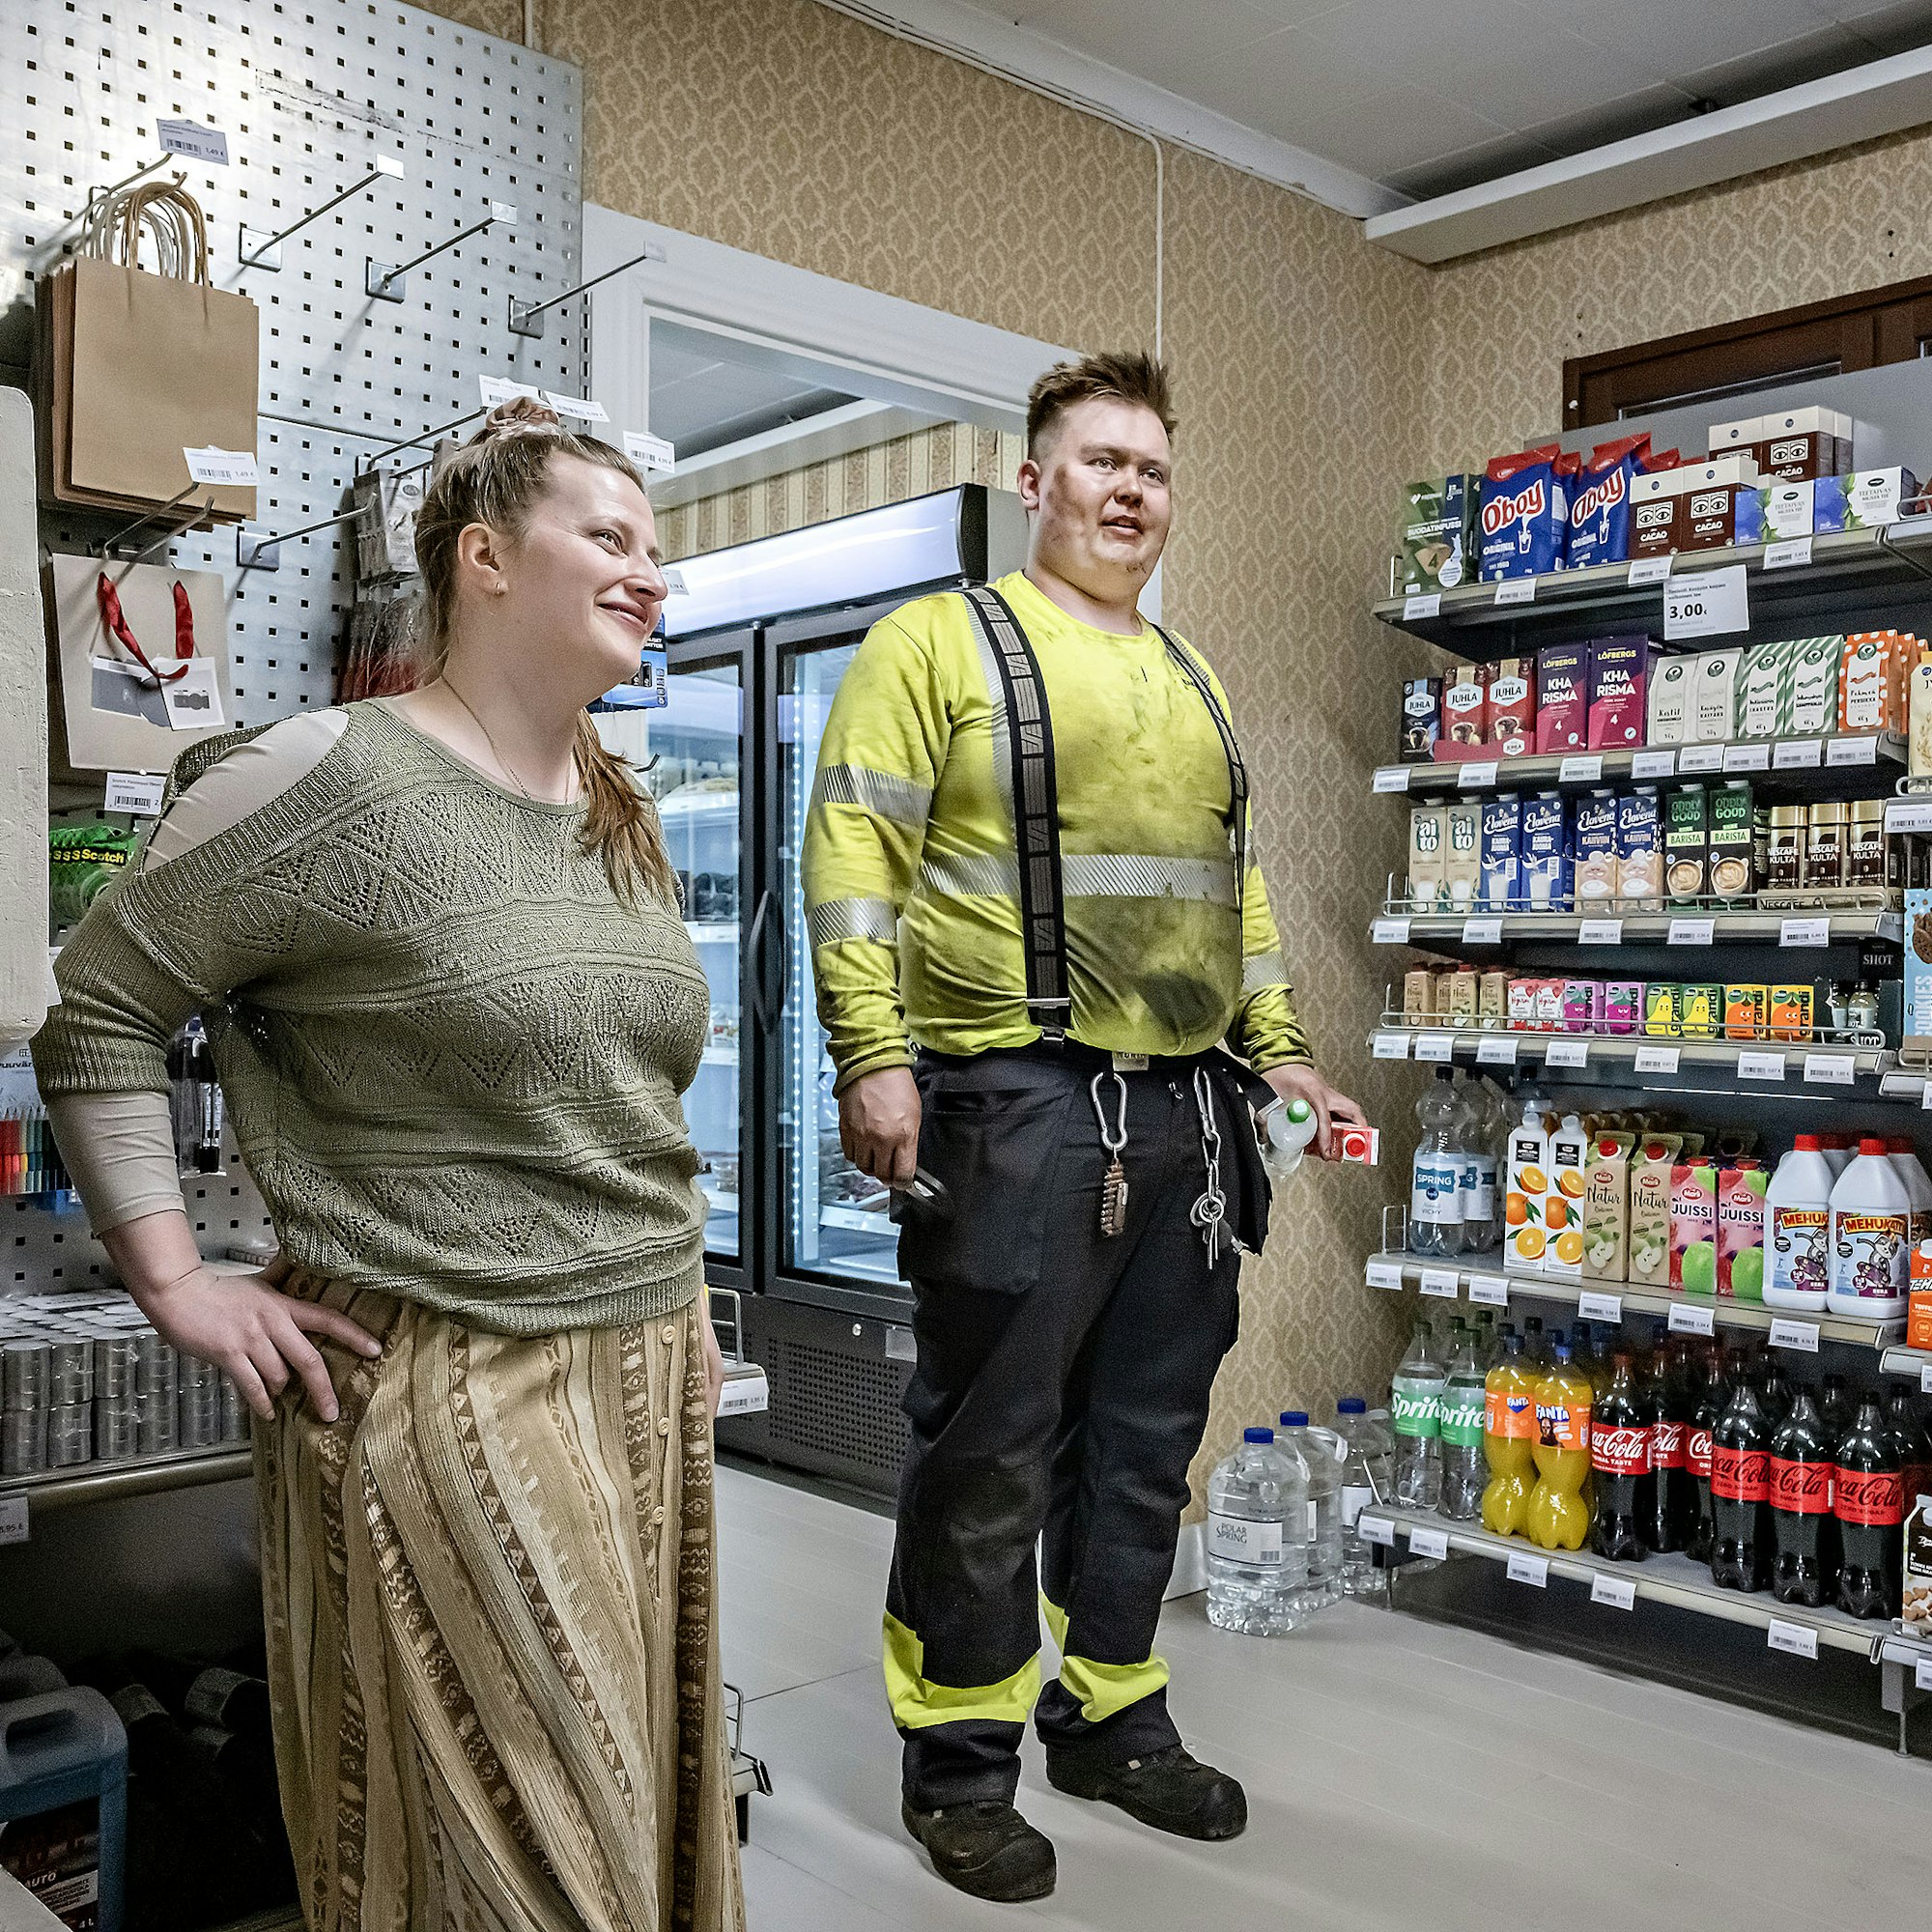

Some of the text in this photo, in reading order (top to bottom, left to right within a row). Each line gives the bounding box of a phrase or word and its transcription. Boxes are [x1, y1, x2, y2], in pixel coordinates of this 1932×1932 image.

[1483, 480, 1545, 535] O'boy
[1694, 521, 1723, 532] CACAO
[1640, 530, 1668, 542] CACAO
[1429, 554, 1437, 568] 4
[1597, 650, 1636, 661] LÖFBERGS
[1543, 658, 1578, 669] LÖFBERGS
[1603, 668, 1631, 683] KHA
[1548, 677, 1573, 691] KHA
[1596, 683, 1636, 697] RISMA
[1451, 693, 1478, 704] JUHLA
[1494, 686, 1522, 699] JUHLA
[1542, 690, 1578, 705] RISMA
[1409, 701, 1431, 710] JUHLA
[1554, 720, 1563, 731] 4
[1609, 714, 1619, 725] 4
[1671, 800, 1700, 811] ODDLY
[1715, 797, 1747, 809] ODDLY
[1619, 809, 1657, 830] Elovena
[1671, 811, 1701, 822] GOOD
[1715, 808, 1747, 819] GOOD
[1419, 817, 1437, 837] ai
[1455, 815, 1472, 836] ai
[1484, 814, 1519, 835] Elovena
[1523, 812, 1561, 833] Elovena
[1577, 810, 1616, 832] Elovena
[1419, 835, 1438, 851] to
[1455, 835, 1474, 850] to
[1670, 835, 1701, 844] BARISTA
[1715, 832, 1747, 842] BARISTA
[1769, 855, 1797, 865] KULTA
[1810, 852, 1837, 863] KULTA
[1853, 851, 1882, 860] KULTA
[1863, 953, 1893, 966] SHOT
[1670, 988, 1681, 1031] grandi
[1707, 989, 1718, 1033] grandi
[1753, 990, 1764, 1035] grandi
[1800, 990, 1810, 1036] grandi
[1416, 1173, 1452, 1187] SPRING
[1587, 1183, 1621, 1205] Natur
[1633, 1188, 1668, 1209] Natur
[1671, 1204, 1713, 1219] JUISSI
[1719, 1207, 1764, 1223] JUISSI
[1845, 1217, 1905, 1233] MEHUKATTI
[1506, 1397, 1529, 1407] FANTA
[1535, 1404, 1570, 1421] FANTA
[1216, 1525, 1248, 1544] SPRING
[1221, 1522, 1247, 1534] POLAR
